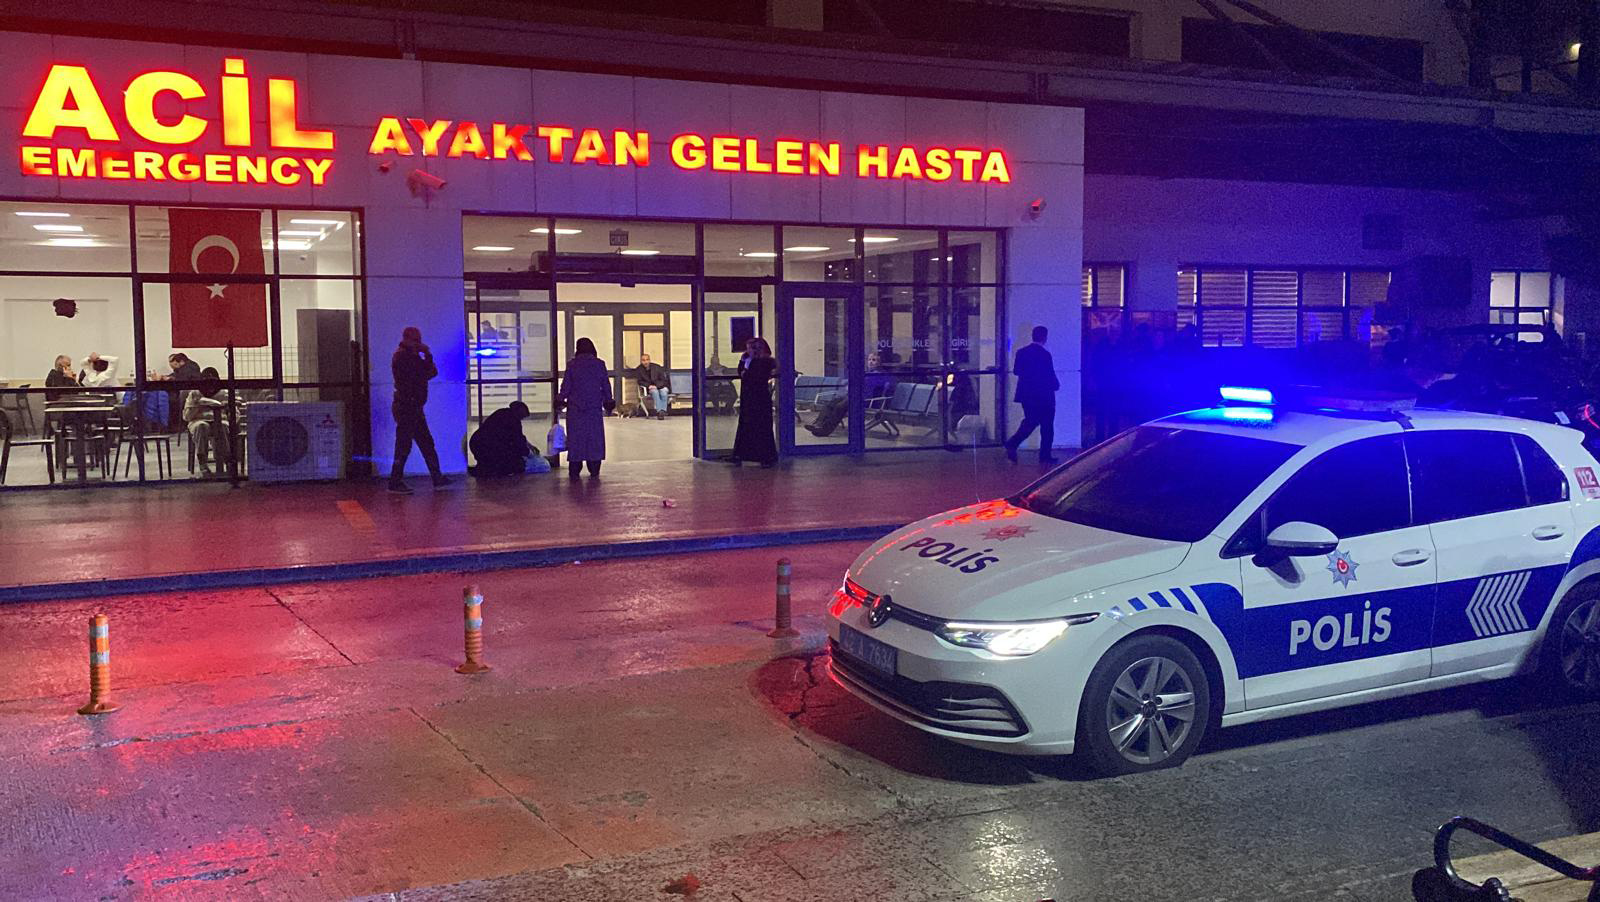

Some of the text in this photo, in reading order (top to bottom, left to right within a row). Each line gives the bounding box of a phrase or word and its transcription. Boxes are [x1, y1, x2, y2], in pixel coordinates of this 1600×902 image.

[22, 57, 334, 149] ACİL
[21, 146, 334, 185] EMERGENCY
[368, 117, 1010, 183] AYAKTAN GELEN HASTA
[899, 537, 1000, 574] POLİS
[1289, 600, 1392, 655] POLİS
